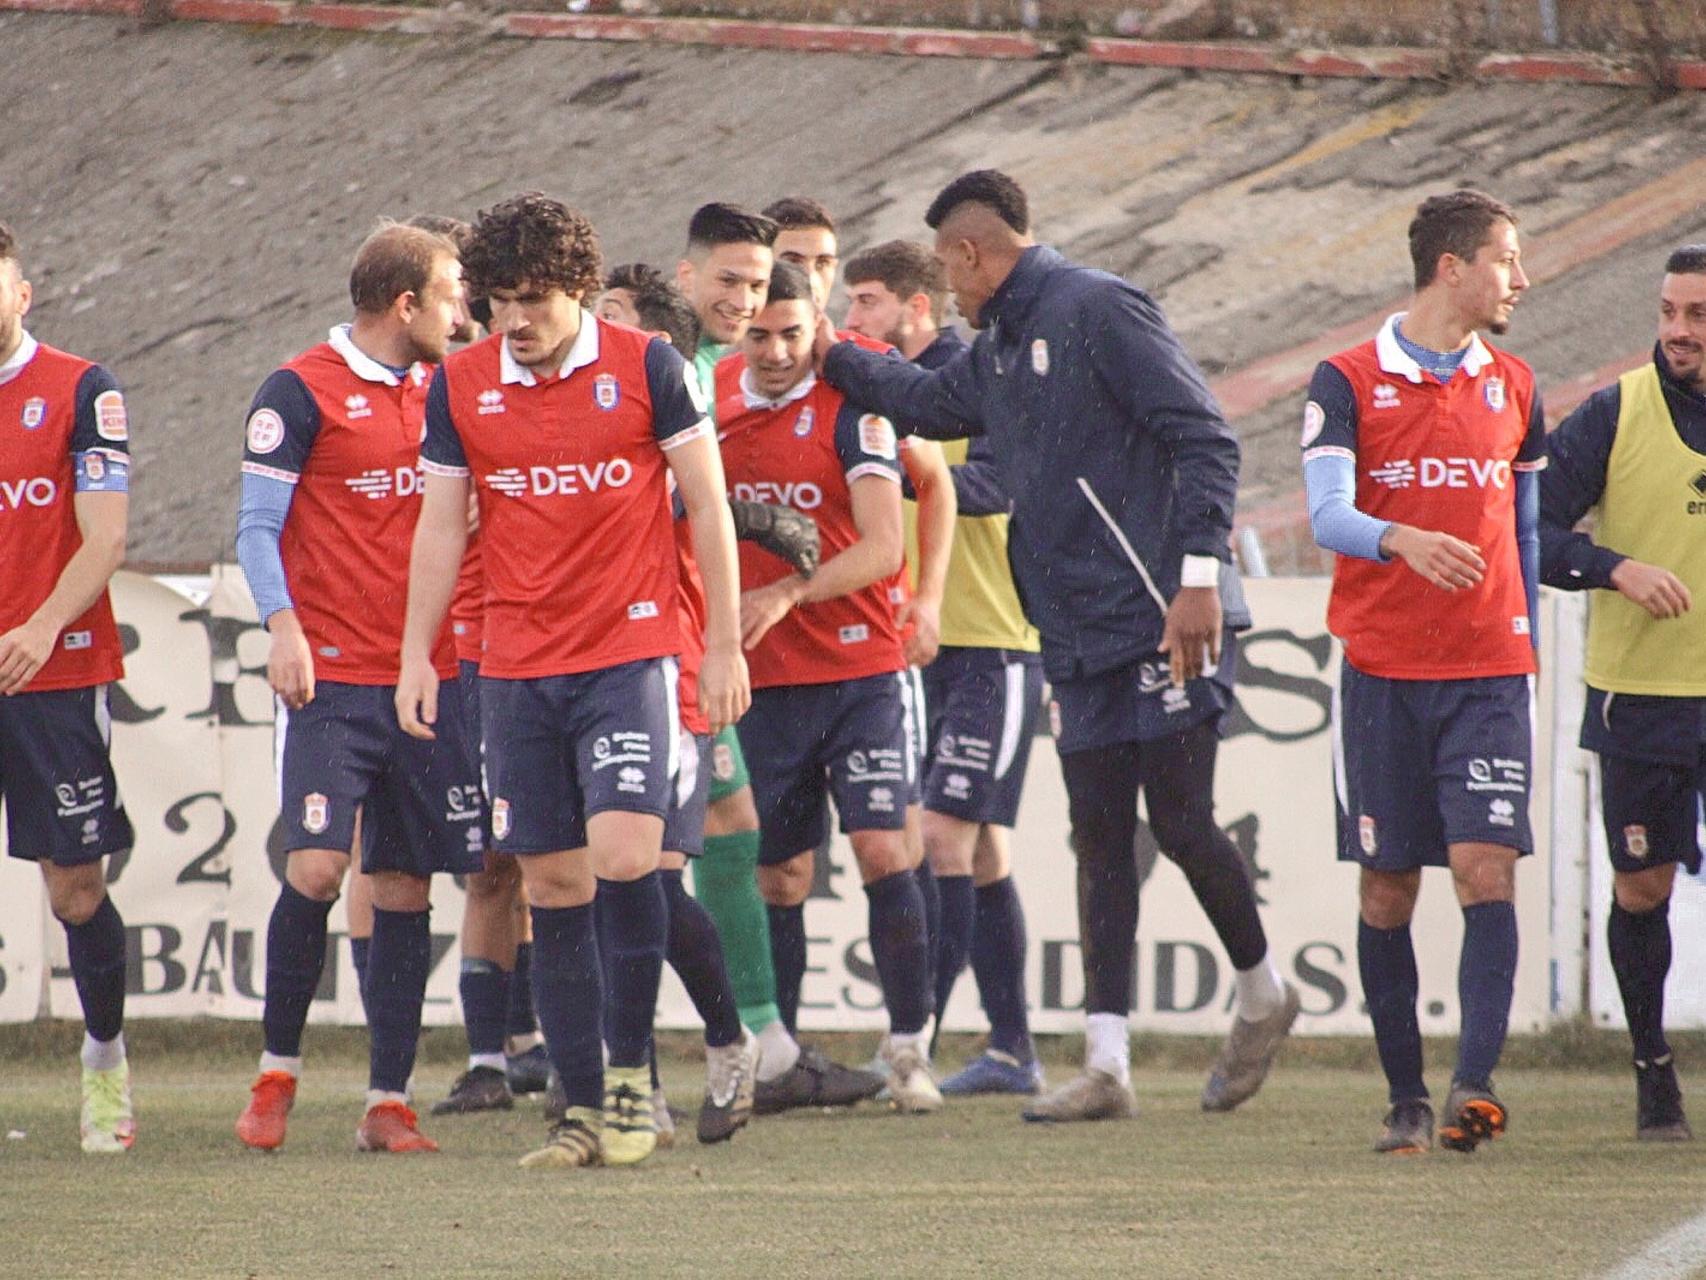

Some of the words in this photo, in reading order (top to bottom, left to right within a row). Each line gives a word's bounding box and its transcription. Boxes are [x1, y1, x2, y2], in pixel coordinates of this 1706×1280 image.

[530, 458, 633, 496] DEVO
[1420, 457, 1510, 489] DEVO
[0, 477, 56, 508] VO
[734, 482, 823, 509] DEVO
[1687, 501, 1706, 515] er
